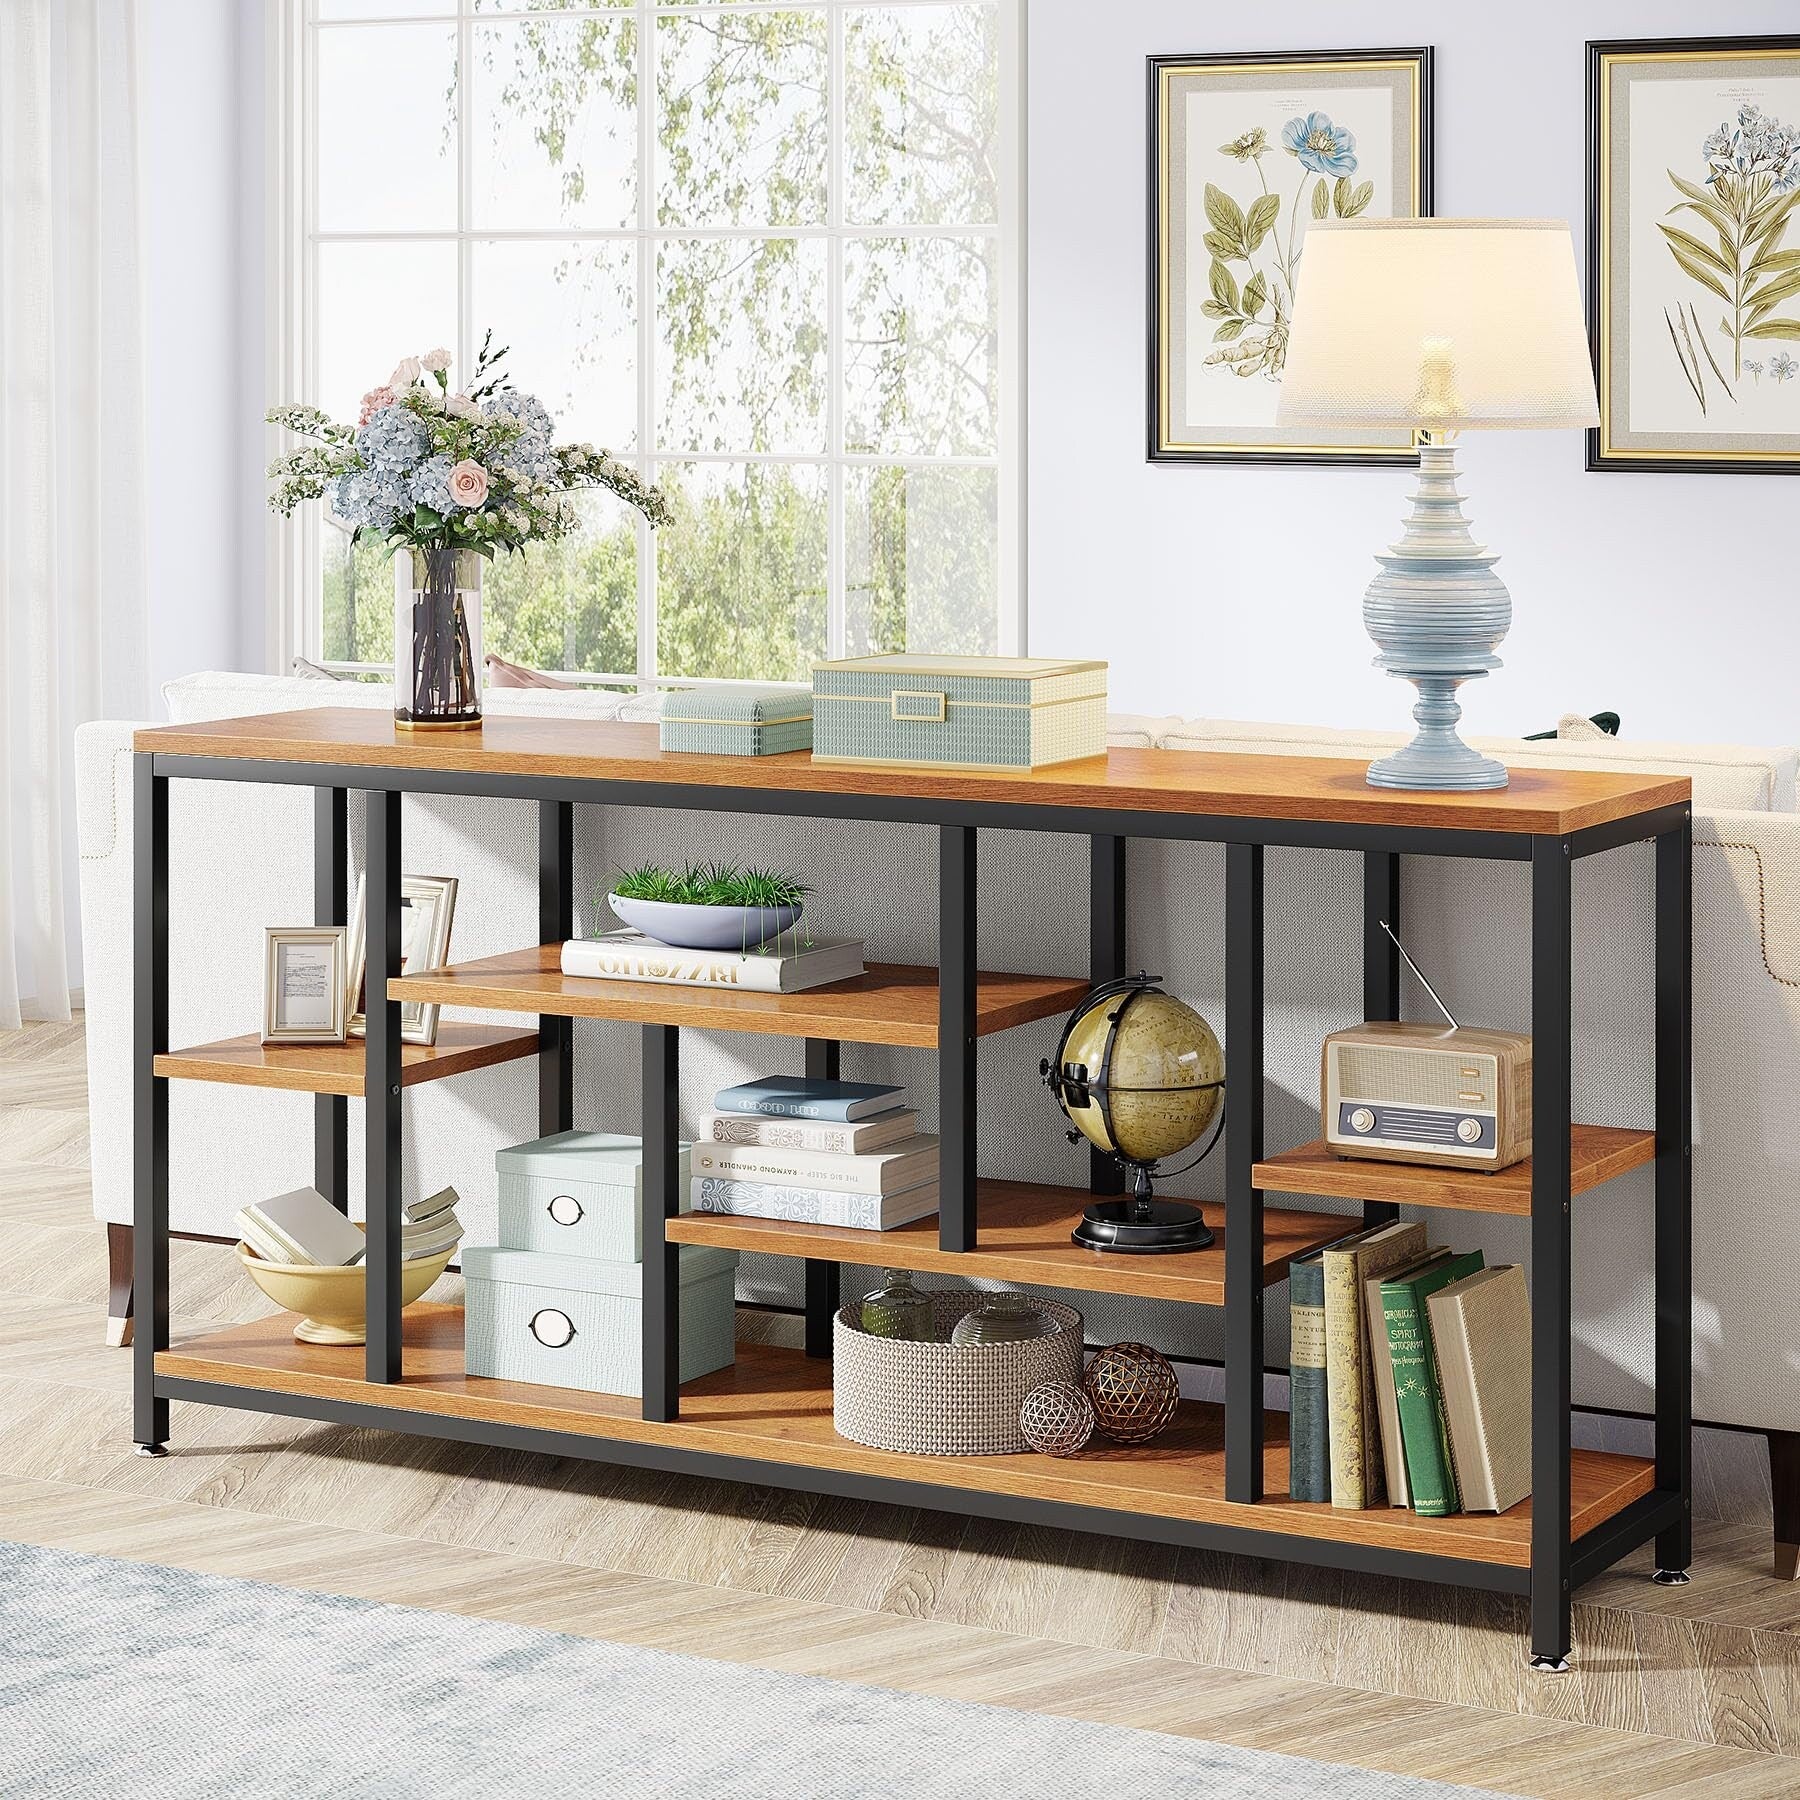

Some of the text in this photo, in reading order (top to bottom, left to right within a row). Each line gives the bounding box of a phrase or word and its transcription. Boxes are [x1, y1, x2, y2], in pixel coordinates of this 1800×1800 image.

[738, 1100, 820, 1116] art deco
[718, 1160, 859, 1183] THE BIG SLEEP RAYMOND CHANDLER
[1390, 1327, 1418, 1339] SPIRIT
